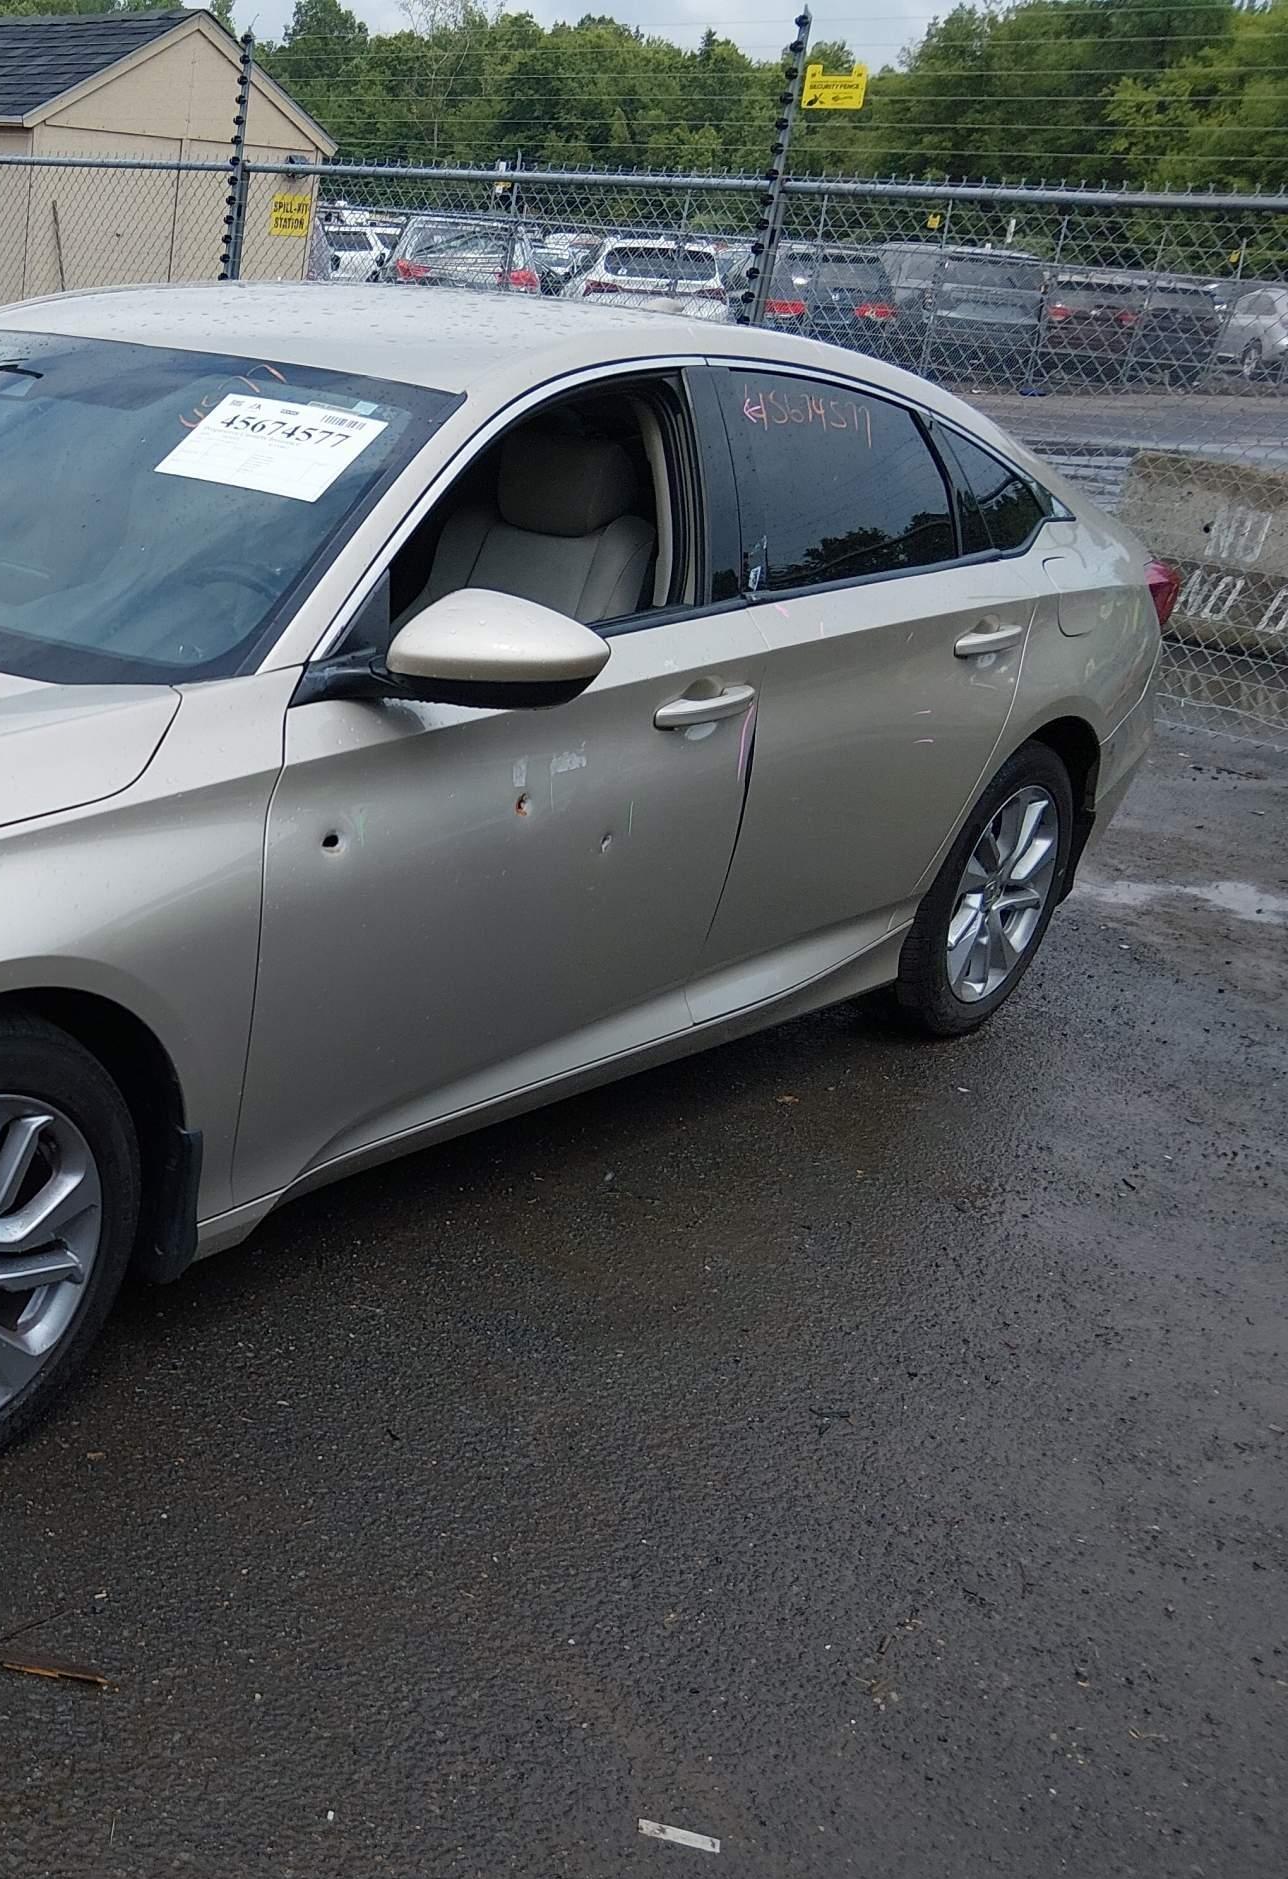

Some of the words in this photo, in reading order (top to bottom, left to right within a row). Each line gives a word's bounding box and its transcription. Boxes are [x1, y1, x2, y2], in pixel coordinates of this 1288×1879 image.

[273, 201, 309, 213] SPILL-KIT
[273, 217, 305, 230] STATION
[220, 414, 353, 448] 45674577
